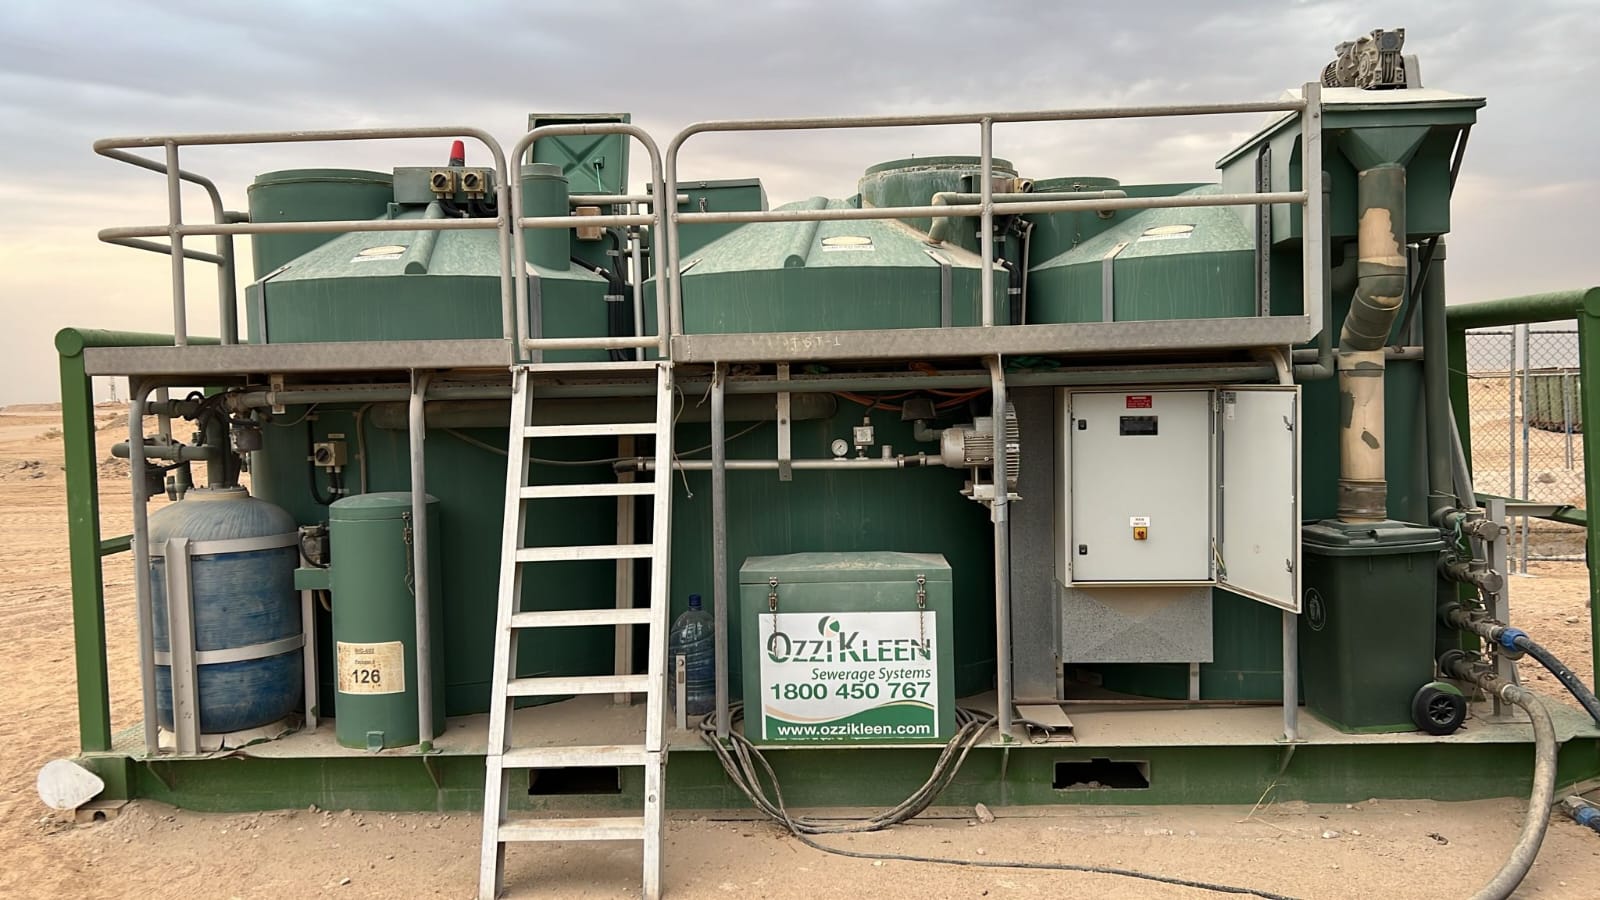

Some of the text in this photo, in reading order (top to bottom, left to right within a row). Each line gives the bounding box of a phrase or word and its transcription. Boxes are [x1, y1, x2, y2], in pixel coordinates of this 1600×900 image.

[352, 669, 380, 683] 126
[811, 667, 931, 682] Sewerage Systems
[770, 682, 931, 700] 1800 450 767
[777, 722, 930, 736] www.ozzikleen.com
